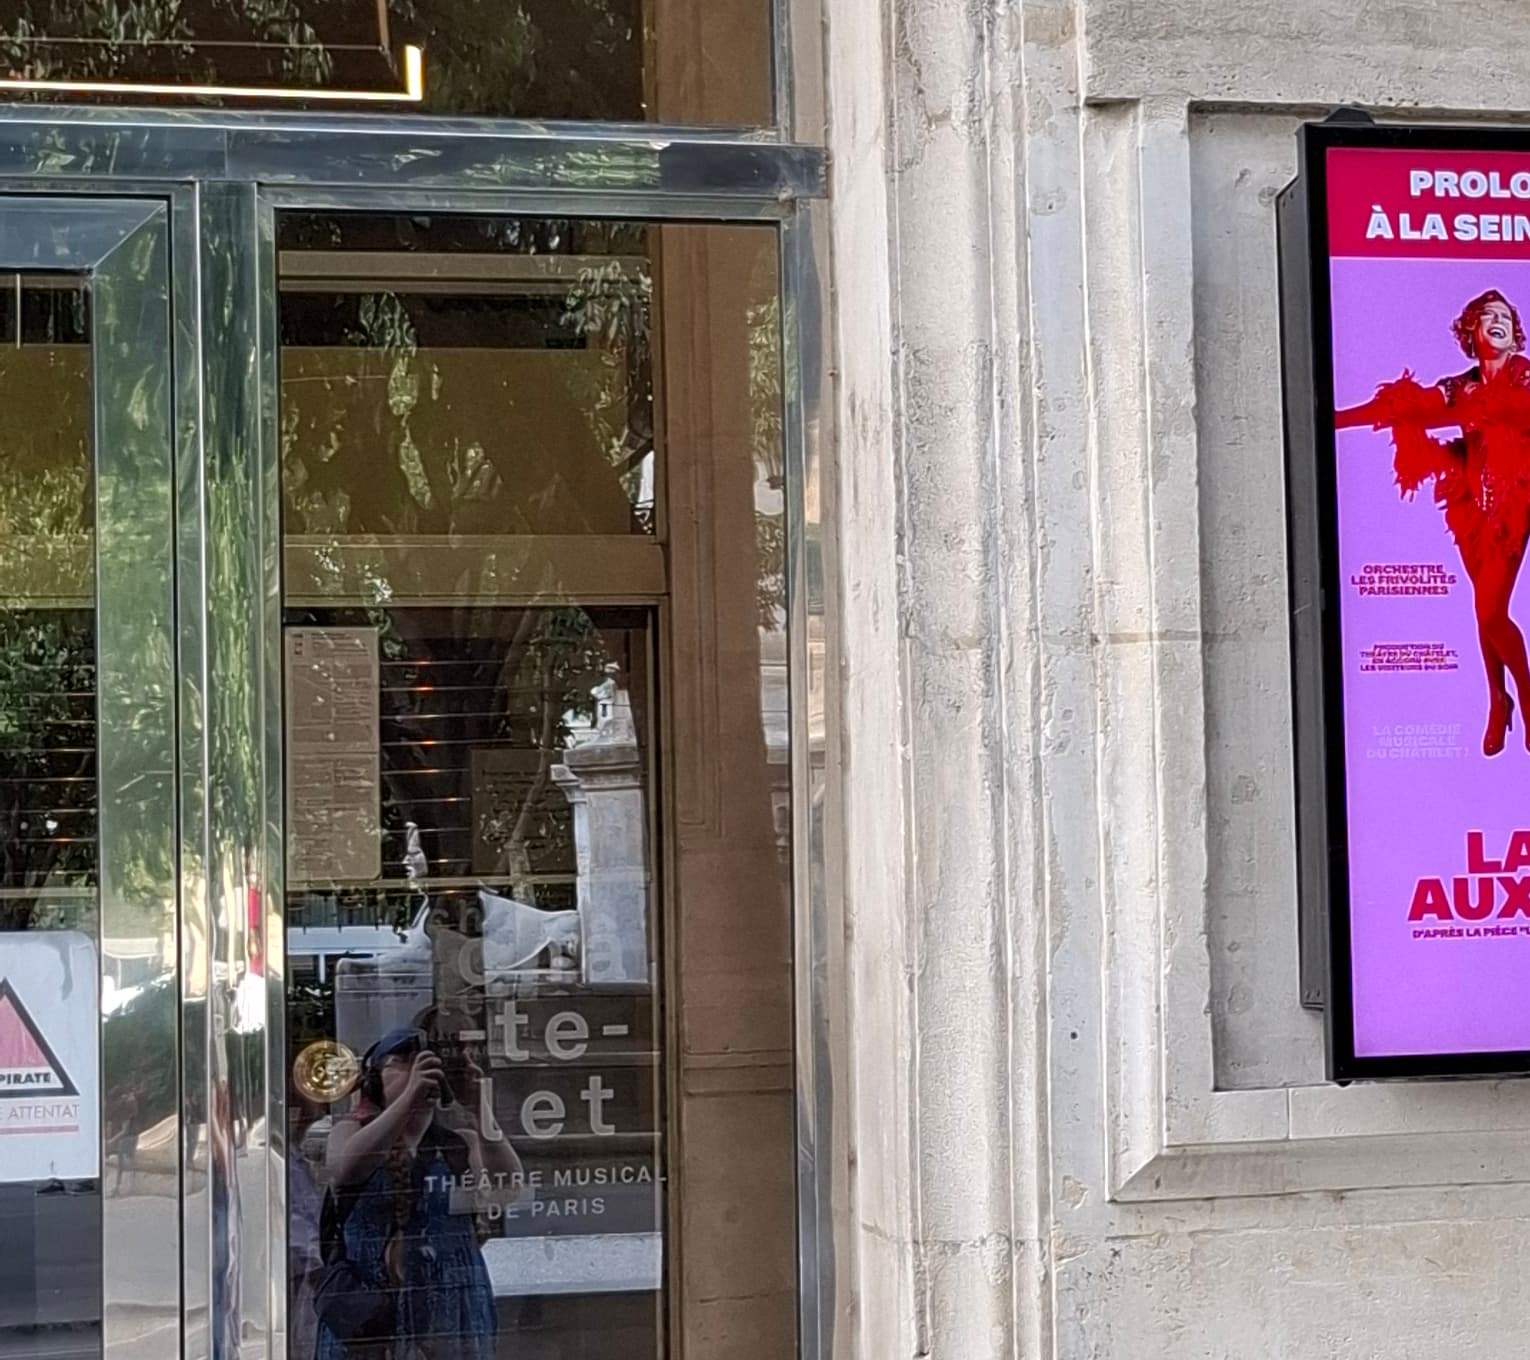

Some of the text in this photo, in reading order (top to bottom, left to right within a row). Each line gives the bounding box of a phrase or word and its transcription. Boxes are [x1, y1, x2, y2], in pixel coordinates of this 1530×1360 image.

[1366, 205, 1394, 240] À
[1399, 213, 1452, 241] LA
[1363, 564, 1444, 575] ORCHESTRE
[1351, 573, 1457, 586] LES FRIVOLITÉS
[1359, 586, 1449, 596] PARISIENNES
[1412, 927, 1464, 939] D'APRÈS
[1466, 928, 1482, 937] LA
[1483, 925, 1517, 937] PIÈCE
[8, 1103, 80, 1121] ATTENTAT
[479, 1075, 616, 1141] let
[424, 1165, 667, 1193] THÉÂTRE MUSICAL
[487, 1198, 606, 1220] DE PARIS
